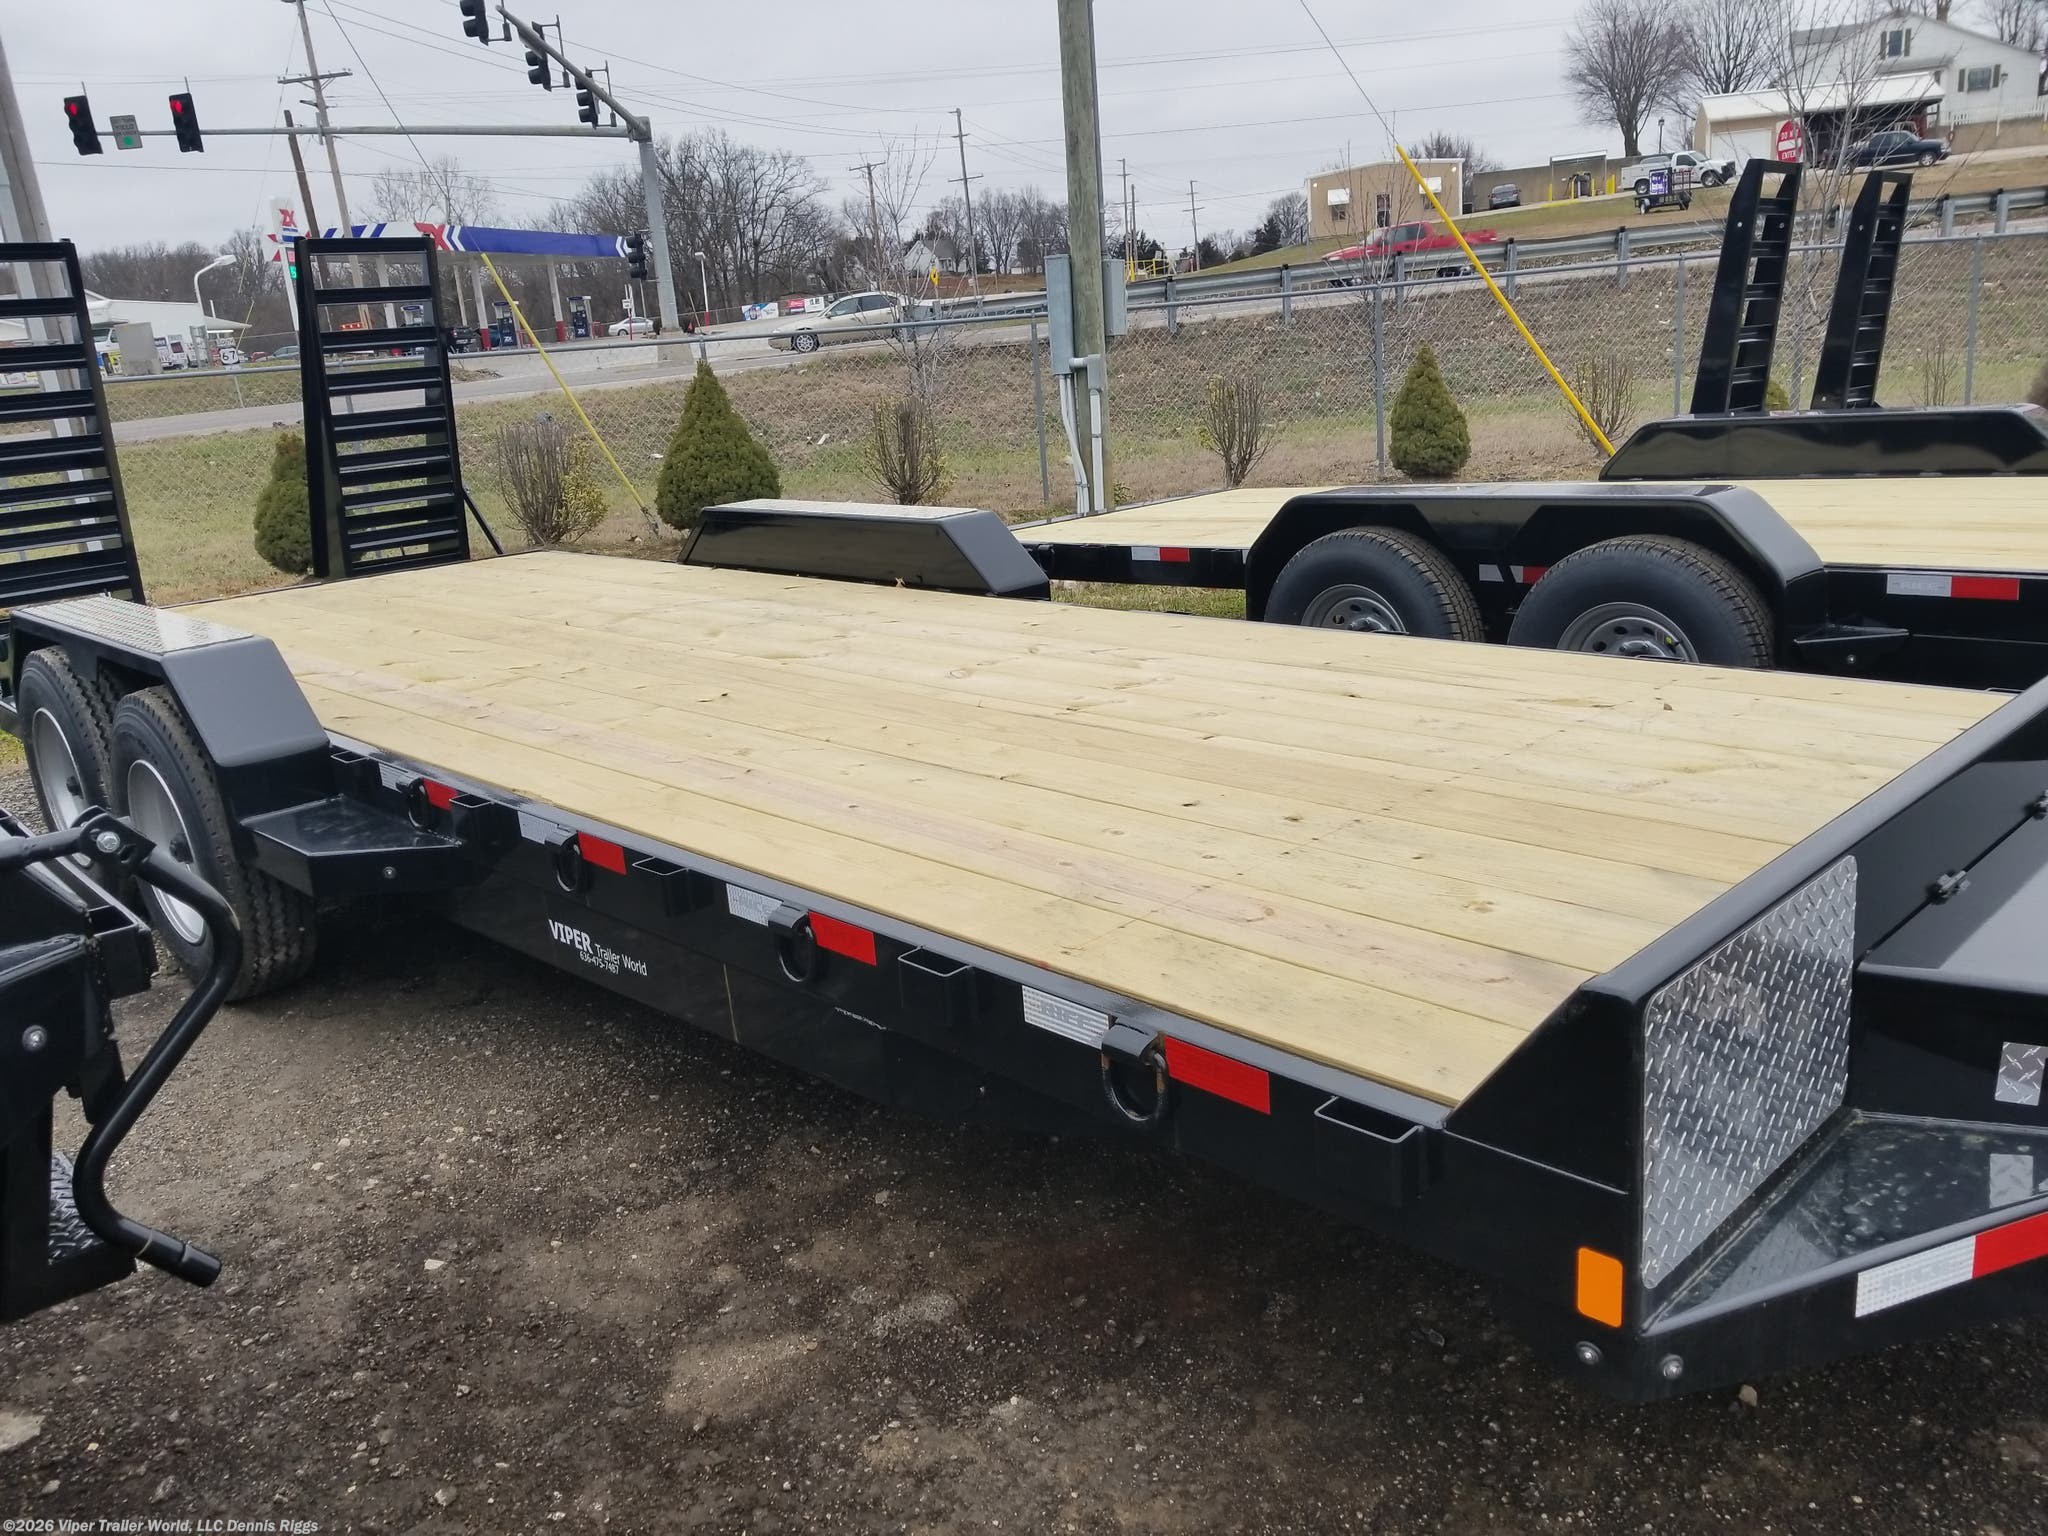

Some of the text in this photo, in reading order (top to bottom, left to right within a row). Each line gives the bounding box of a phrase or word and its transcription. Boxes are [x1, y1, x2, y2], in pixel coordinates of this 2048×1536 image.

[222, 350, 236, 361] 67
[548, 918, 648, 976] VIPER Trailer World
